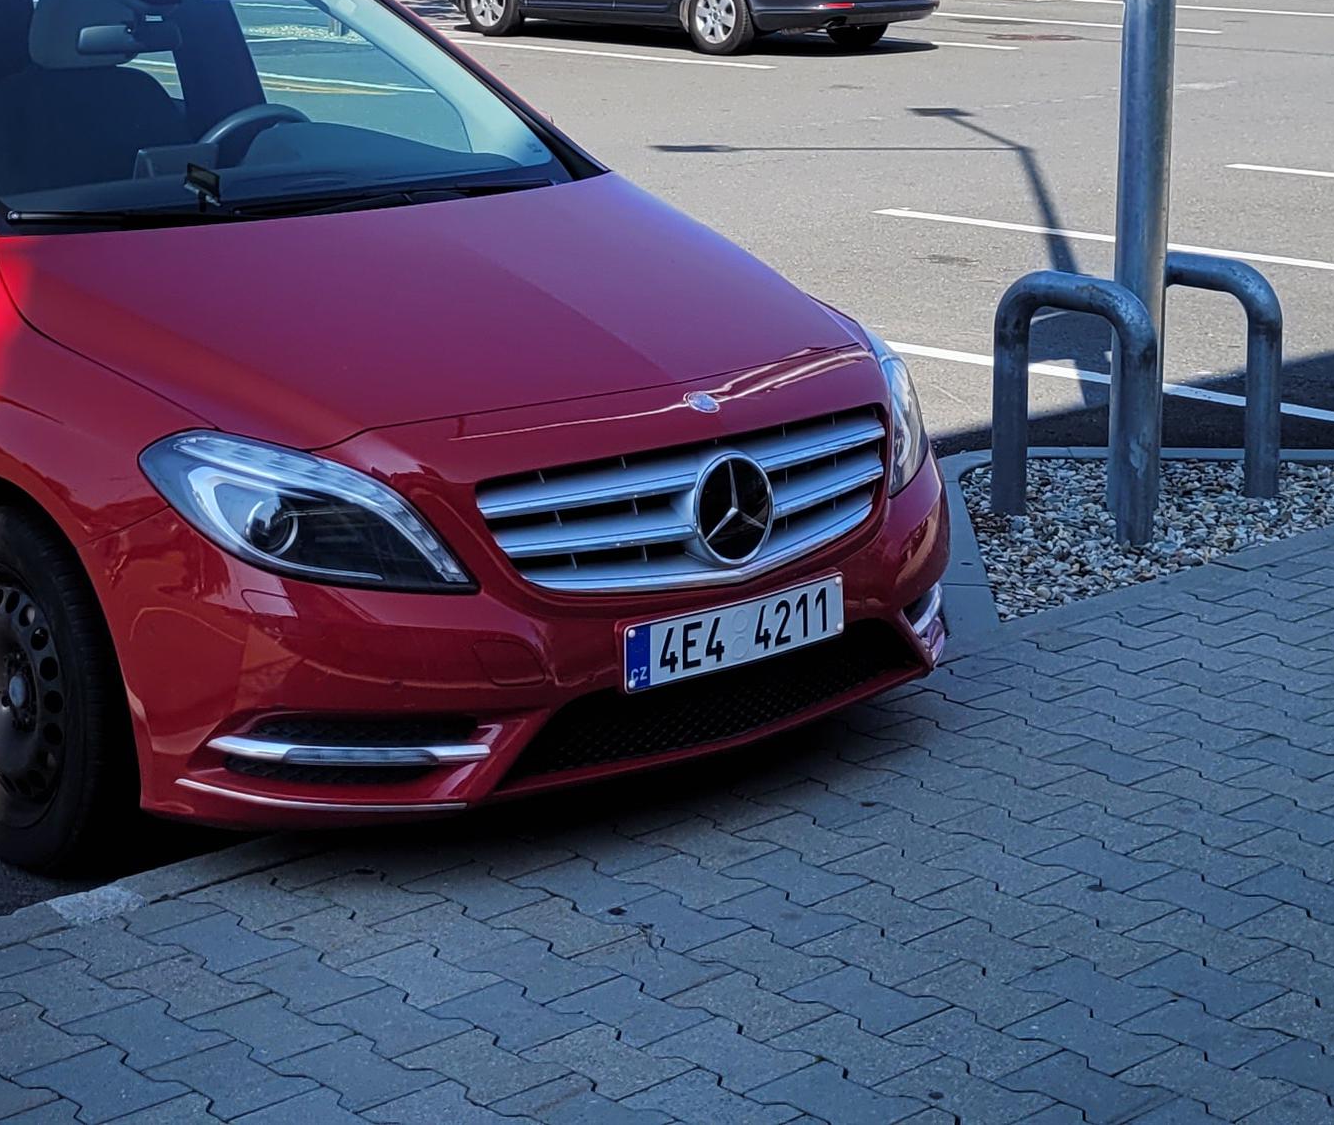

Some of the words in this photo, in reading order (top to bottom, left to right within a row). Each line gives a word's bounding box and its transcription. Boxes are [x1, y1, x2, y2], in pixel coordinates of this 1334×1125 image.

[660, 617, 725, 674] 4E4
[755, 587, 827, 650] 4211
[631, 666, 648, 683] CZ
